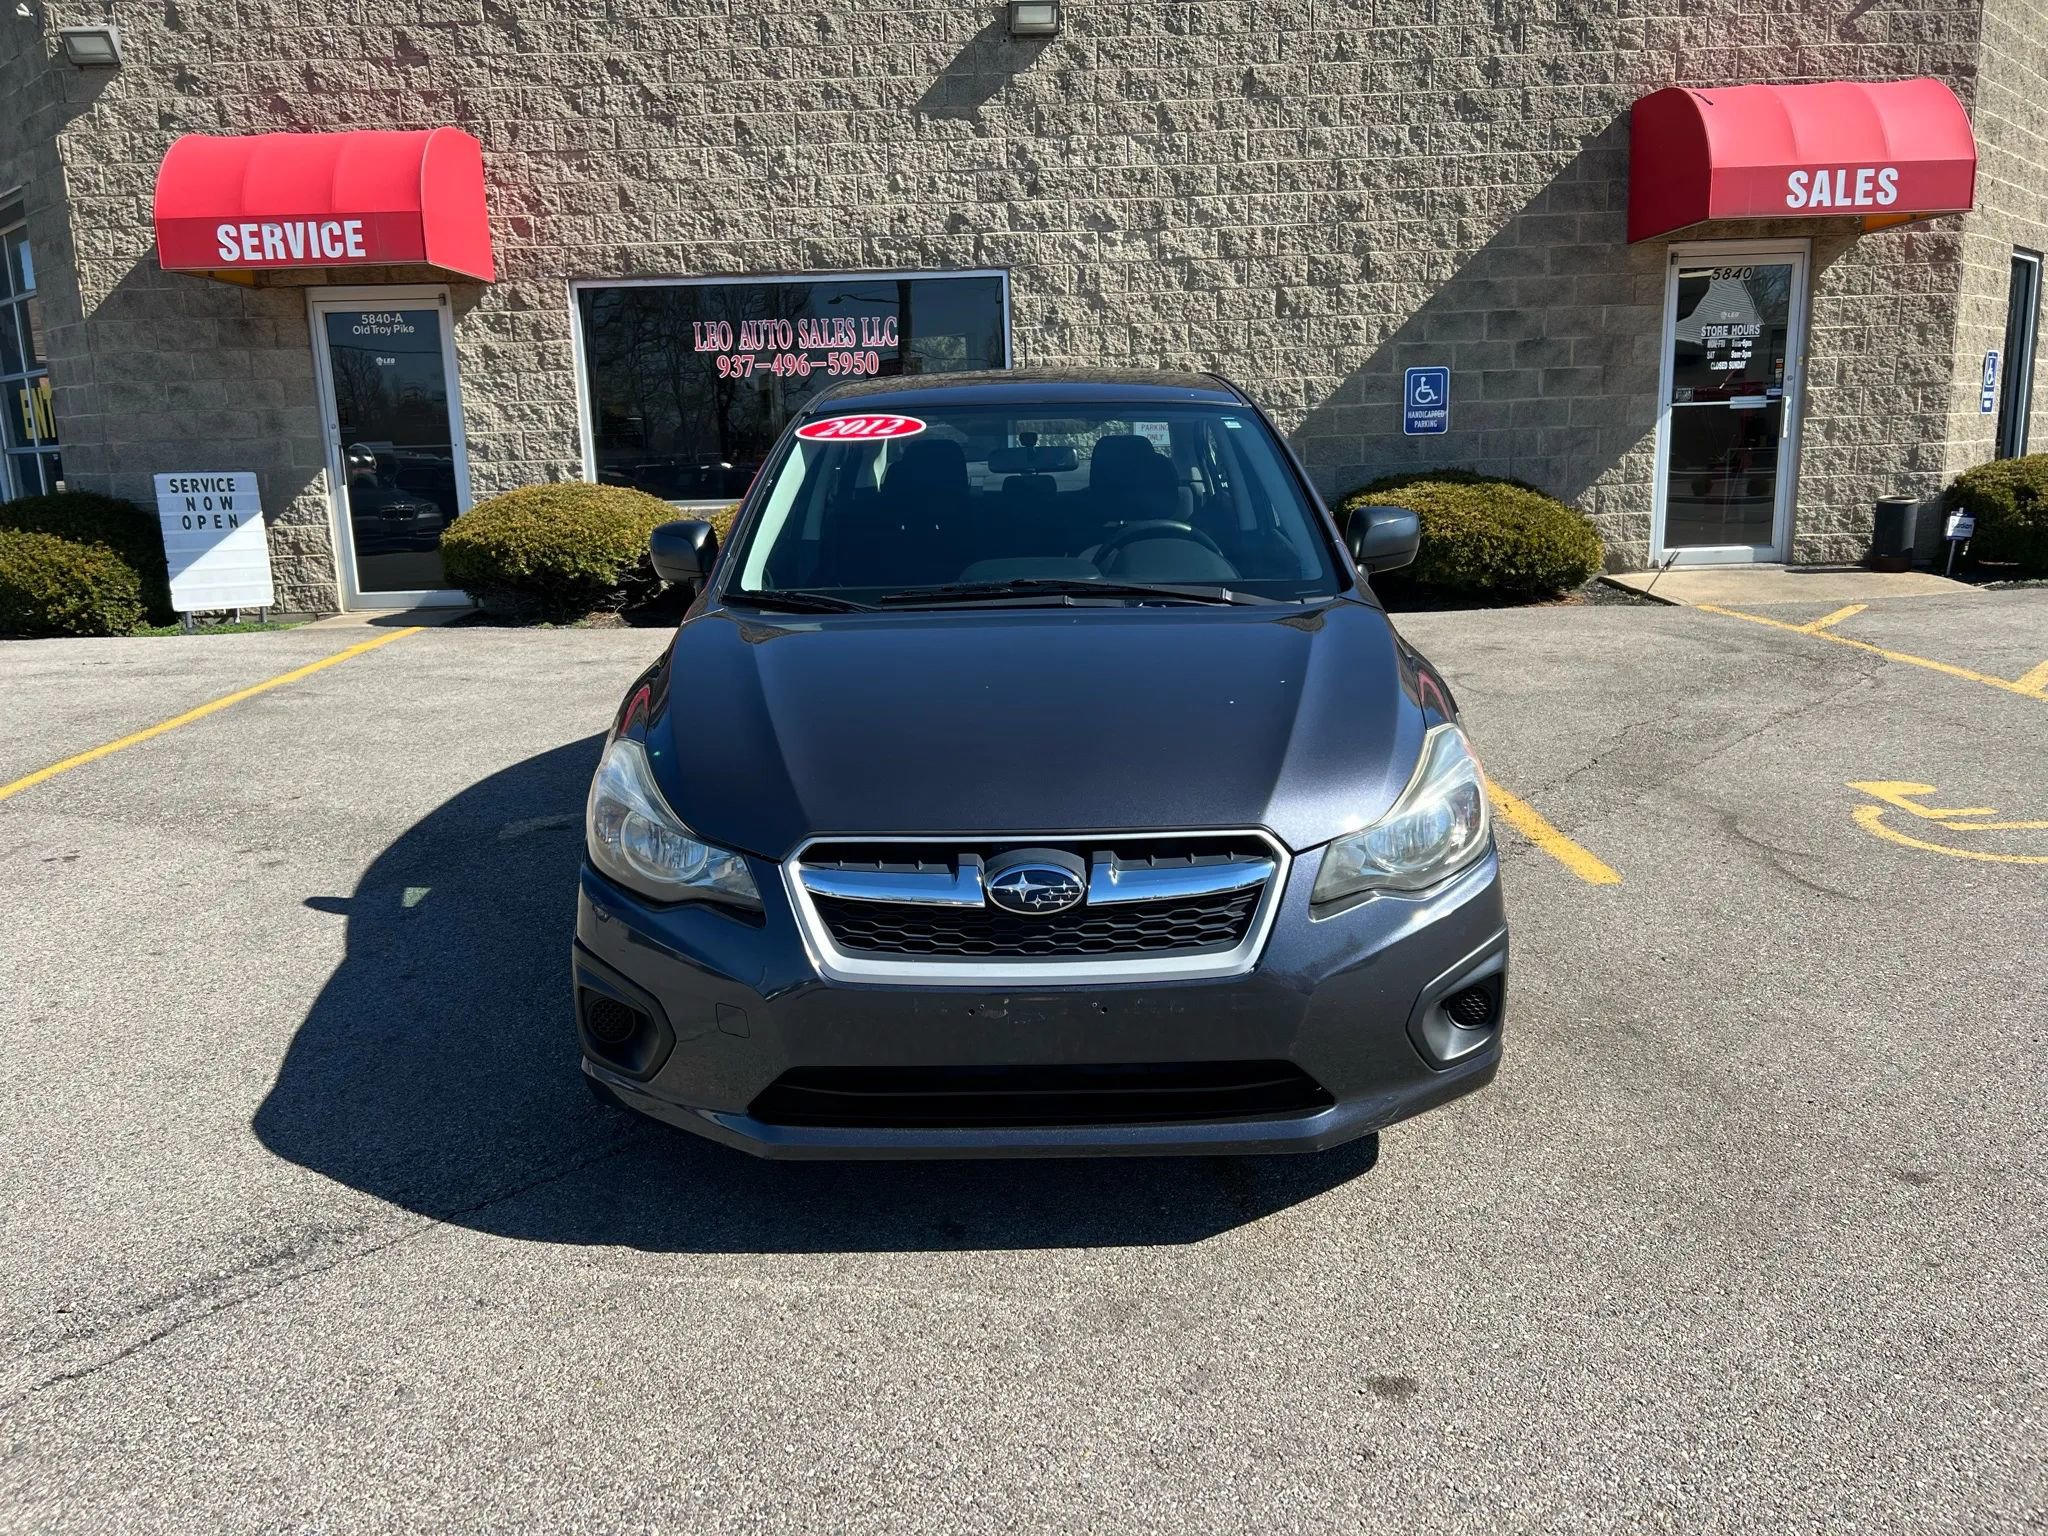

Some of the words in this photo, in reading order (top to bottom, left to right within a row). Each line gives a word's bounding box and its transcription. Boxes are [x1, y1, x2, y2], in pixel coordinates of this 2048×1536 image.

[1786, 167, 1899, 209] SALES
[216, 220, 366, 262] SERVICE
[1711, 267, 1752, 280] 5840
[361, 313, 404, 325] 5840-A
[352, 325, 371, 335] Old
[370, 325, 392, 336] Troy
[393, 324, 415, 334] Pike
[693, 321, 733, 352] LEO
[739, 319, 794, 350] AUTO
[798, 318, 857, 350] SALES
[860, 316, 899, 347] LLC
[1700, 325, 1729, 337] STORE
[1731, 324, 1760, 336] HOURS
[716, 351, 880, 379] 937-496-5950
[1710, 361, 1728, 370] CLOSED
[1728, 360, 1747, 370] SUNDAY
[1407, 410, 1445, 419] HANDICAPPED
[815, 419, 905, 437] 2012
[1414, 420, 1438, 428] PARKING
[169, 478, 236, 494] SERVICE
[186, 496, 233, 511] NOW
[182, 514, 239, 530] OPEN
